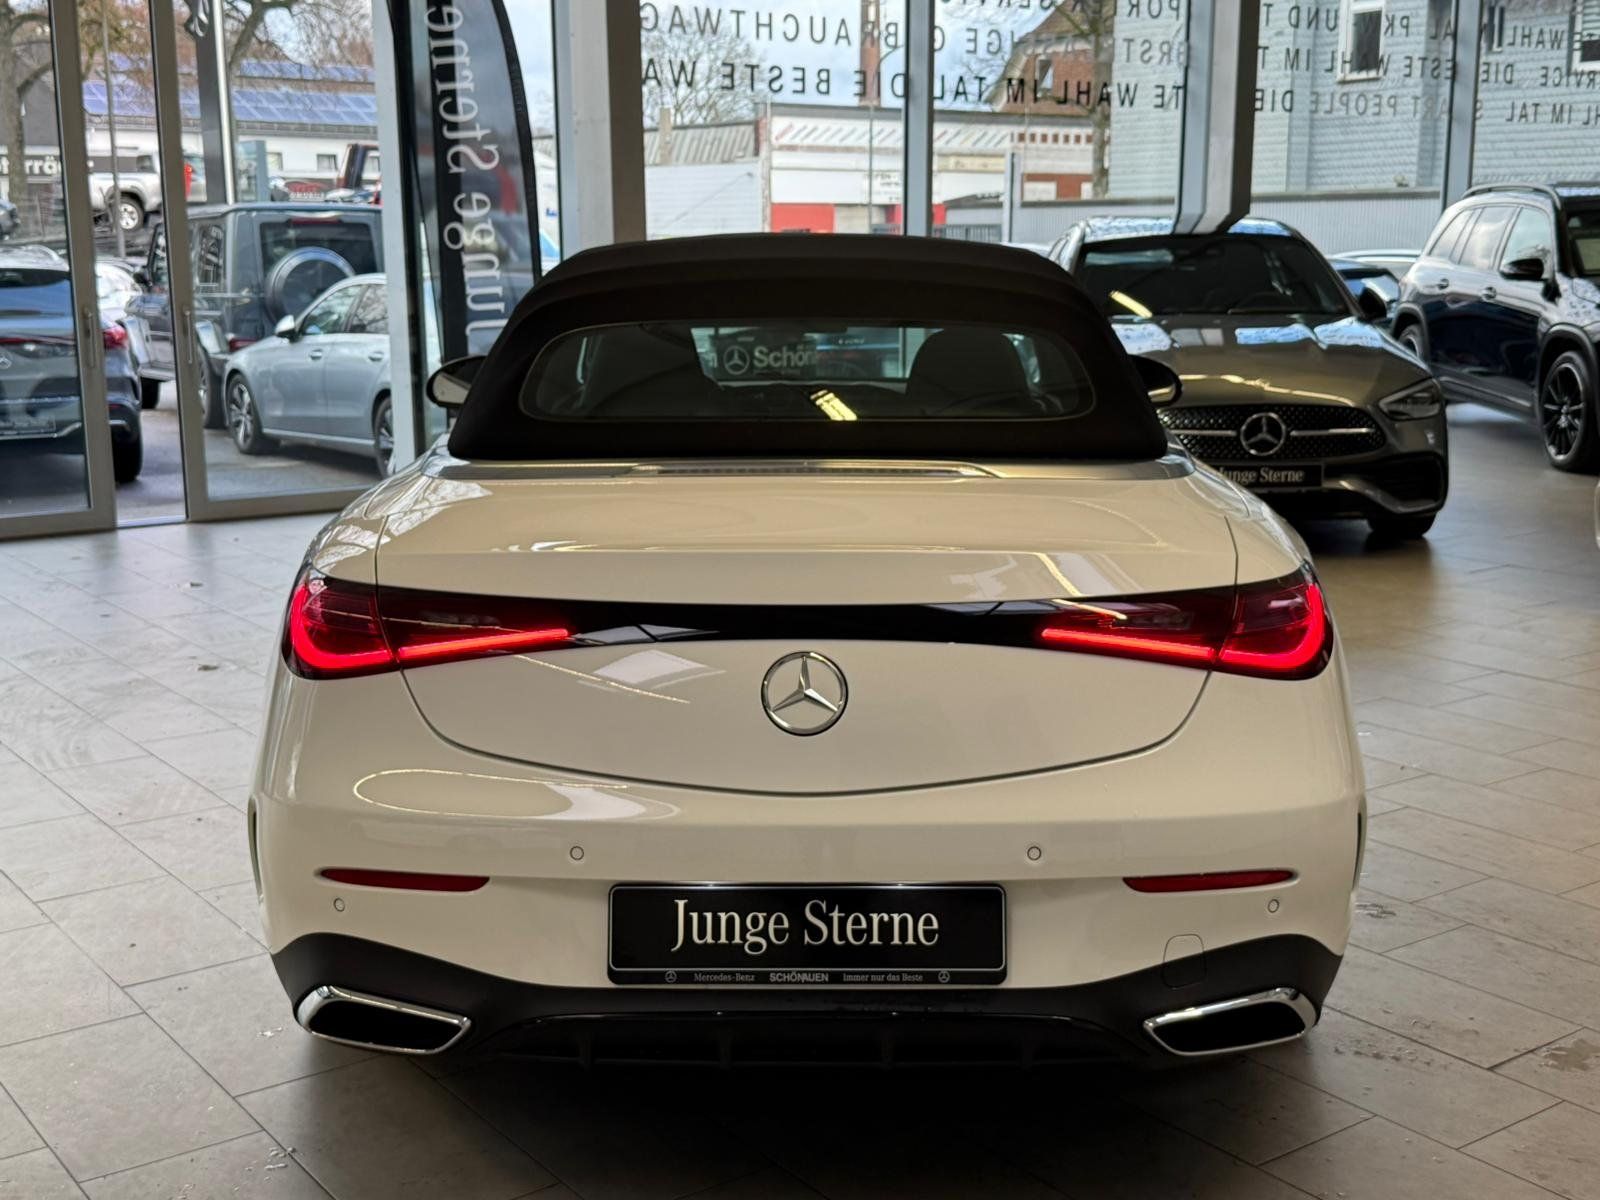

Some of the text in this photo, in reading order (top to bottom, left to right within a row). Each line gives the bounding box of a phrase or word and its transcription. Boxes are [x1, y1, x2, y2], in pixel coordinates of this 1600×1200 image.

[1258, 466, 1305, 483] Sterne
[671, 899, 940, 956] Junge Sterne
[694, 972, 756, 983] Mercedes-Benz
[843, 973, 869, 983] Immer
[870, 974, 885, 983] nur
[886, 973, 900, 983] das
[902, 973, 924, 983] Beste
